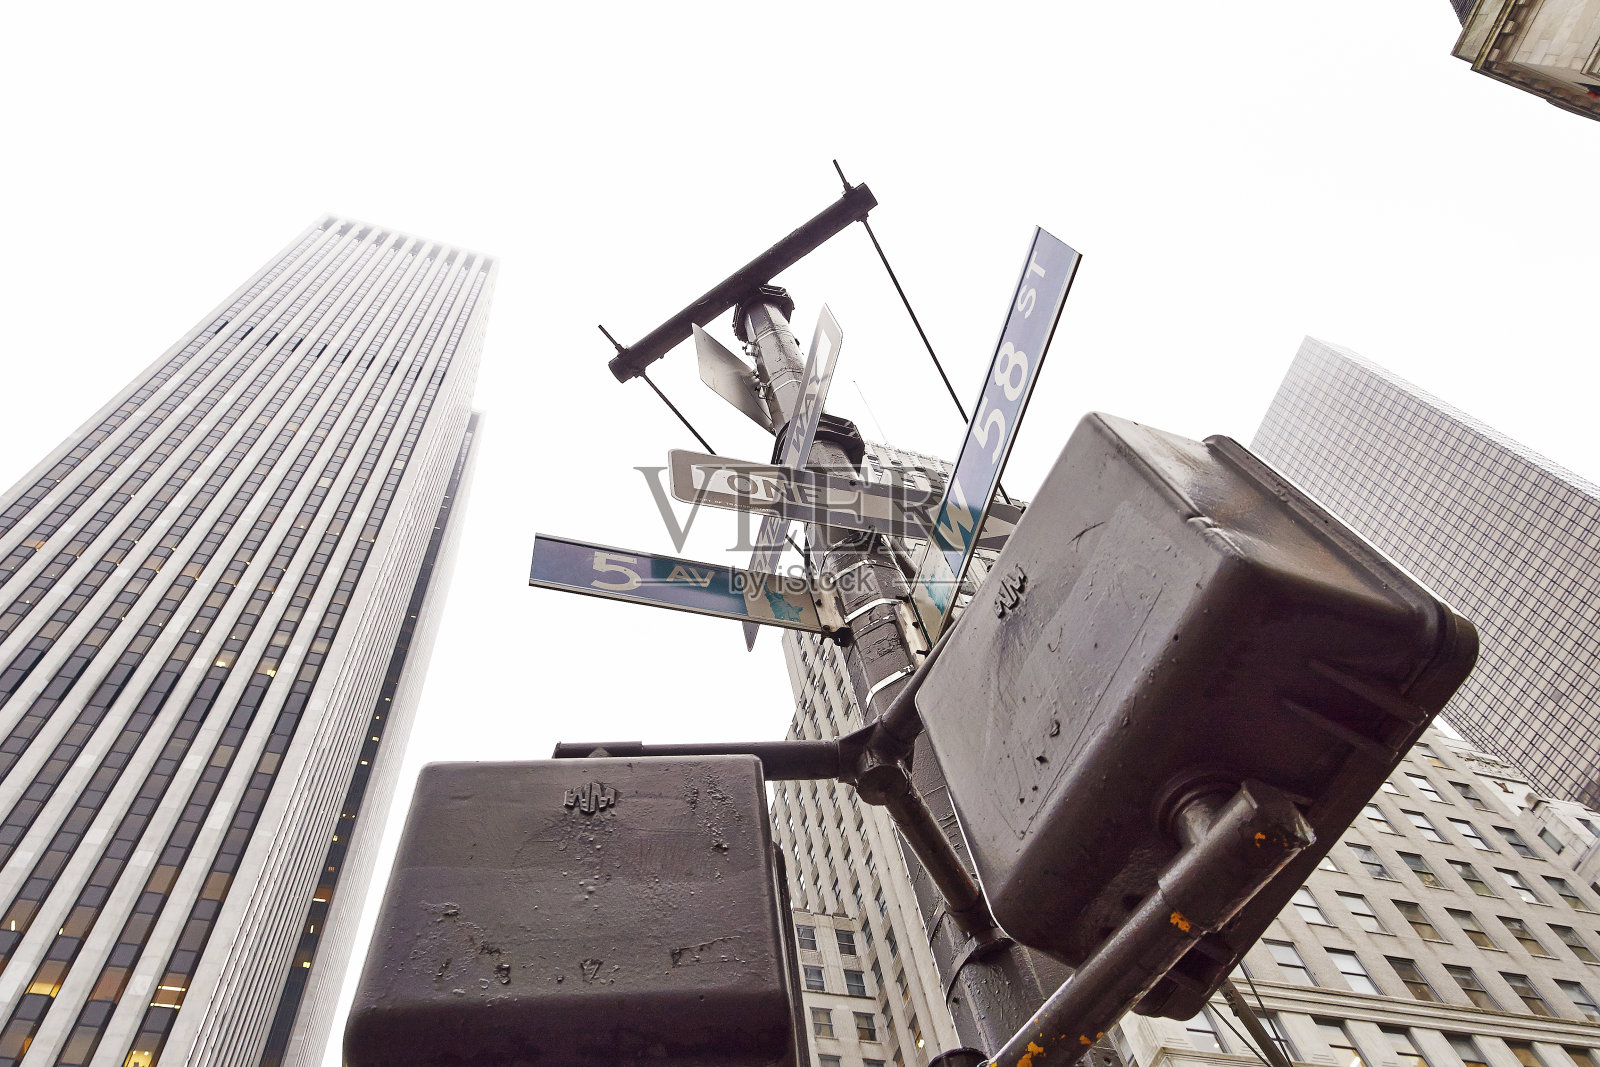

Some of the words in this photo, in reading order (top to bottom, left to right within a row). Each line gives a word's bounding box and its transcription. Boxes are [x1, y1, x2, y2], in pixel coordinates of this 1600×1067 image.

[792, 355, 820, 453] WAY
[939, 477, 974, 556] W
[973, 341, 1029, 465] 58
[1017, 250, 1046, 319] ST
[726, 474, 828, 506] ONE
[591, 551, 641, 590] 5
[666, 566, 715, 587] AV
